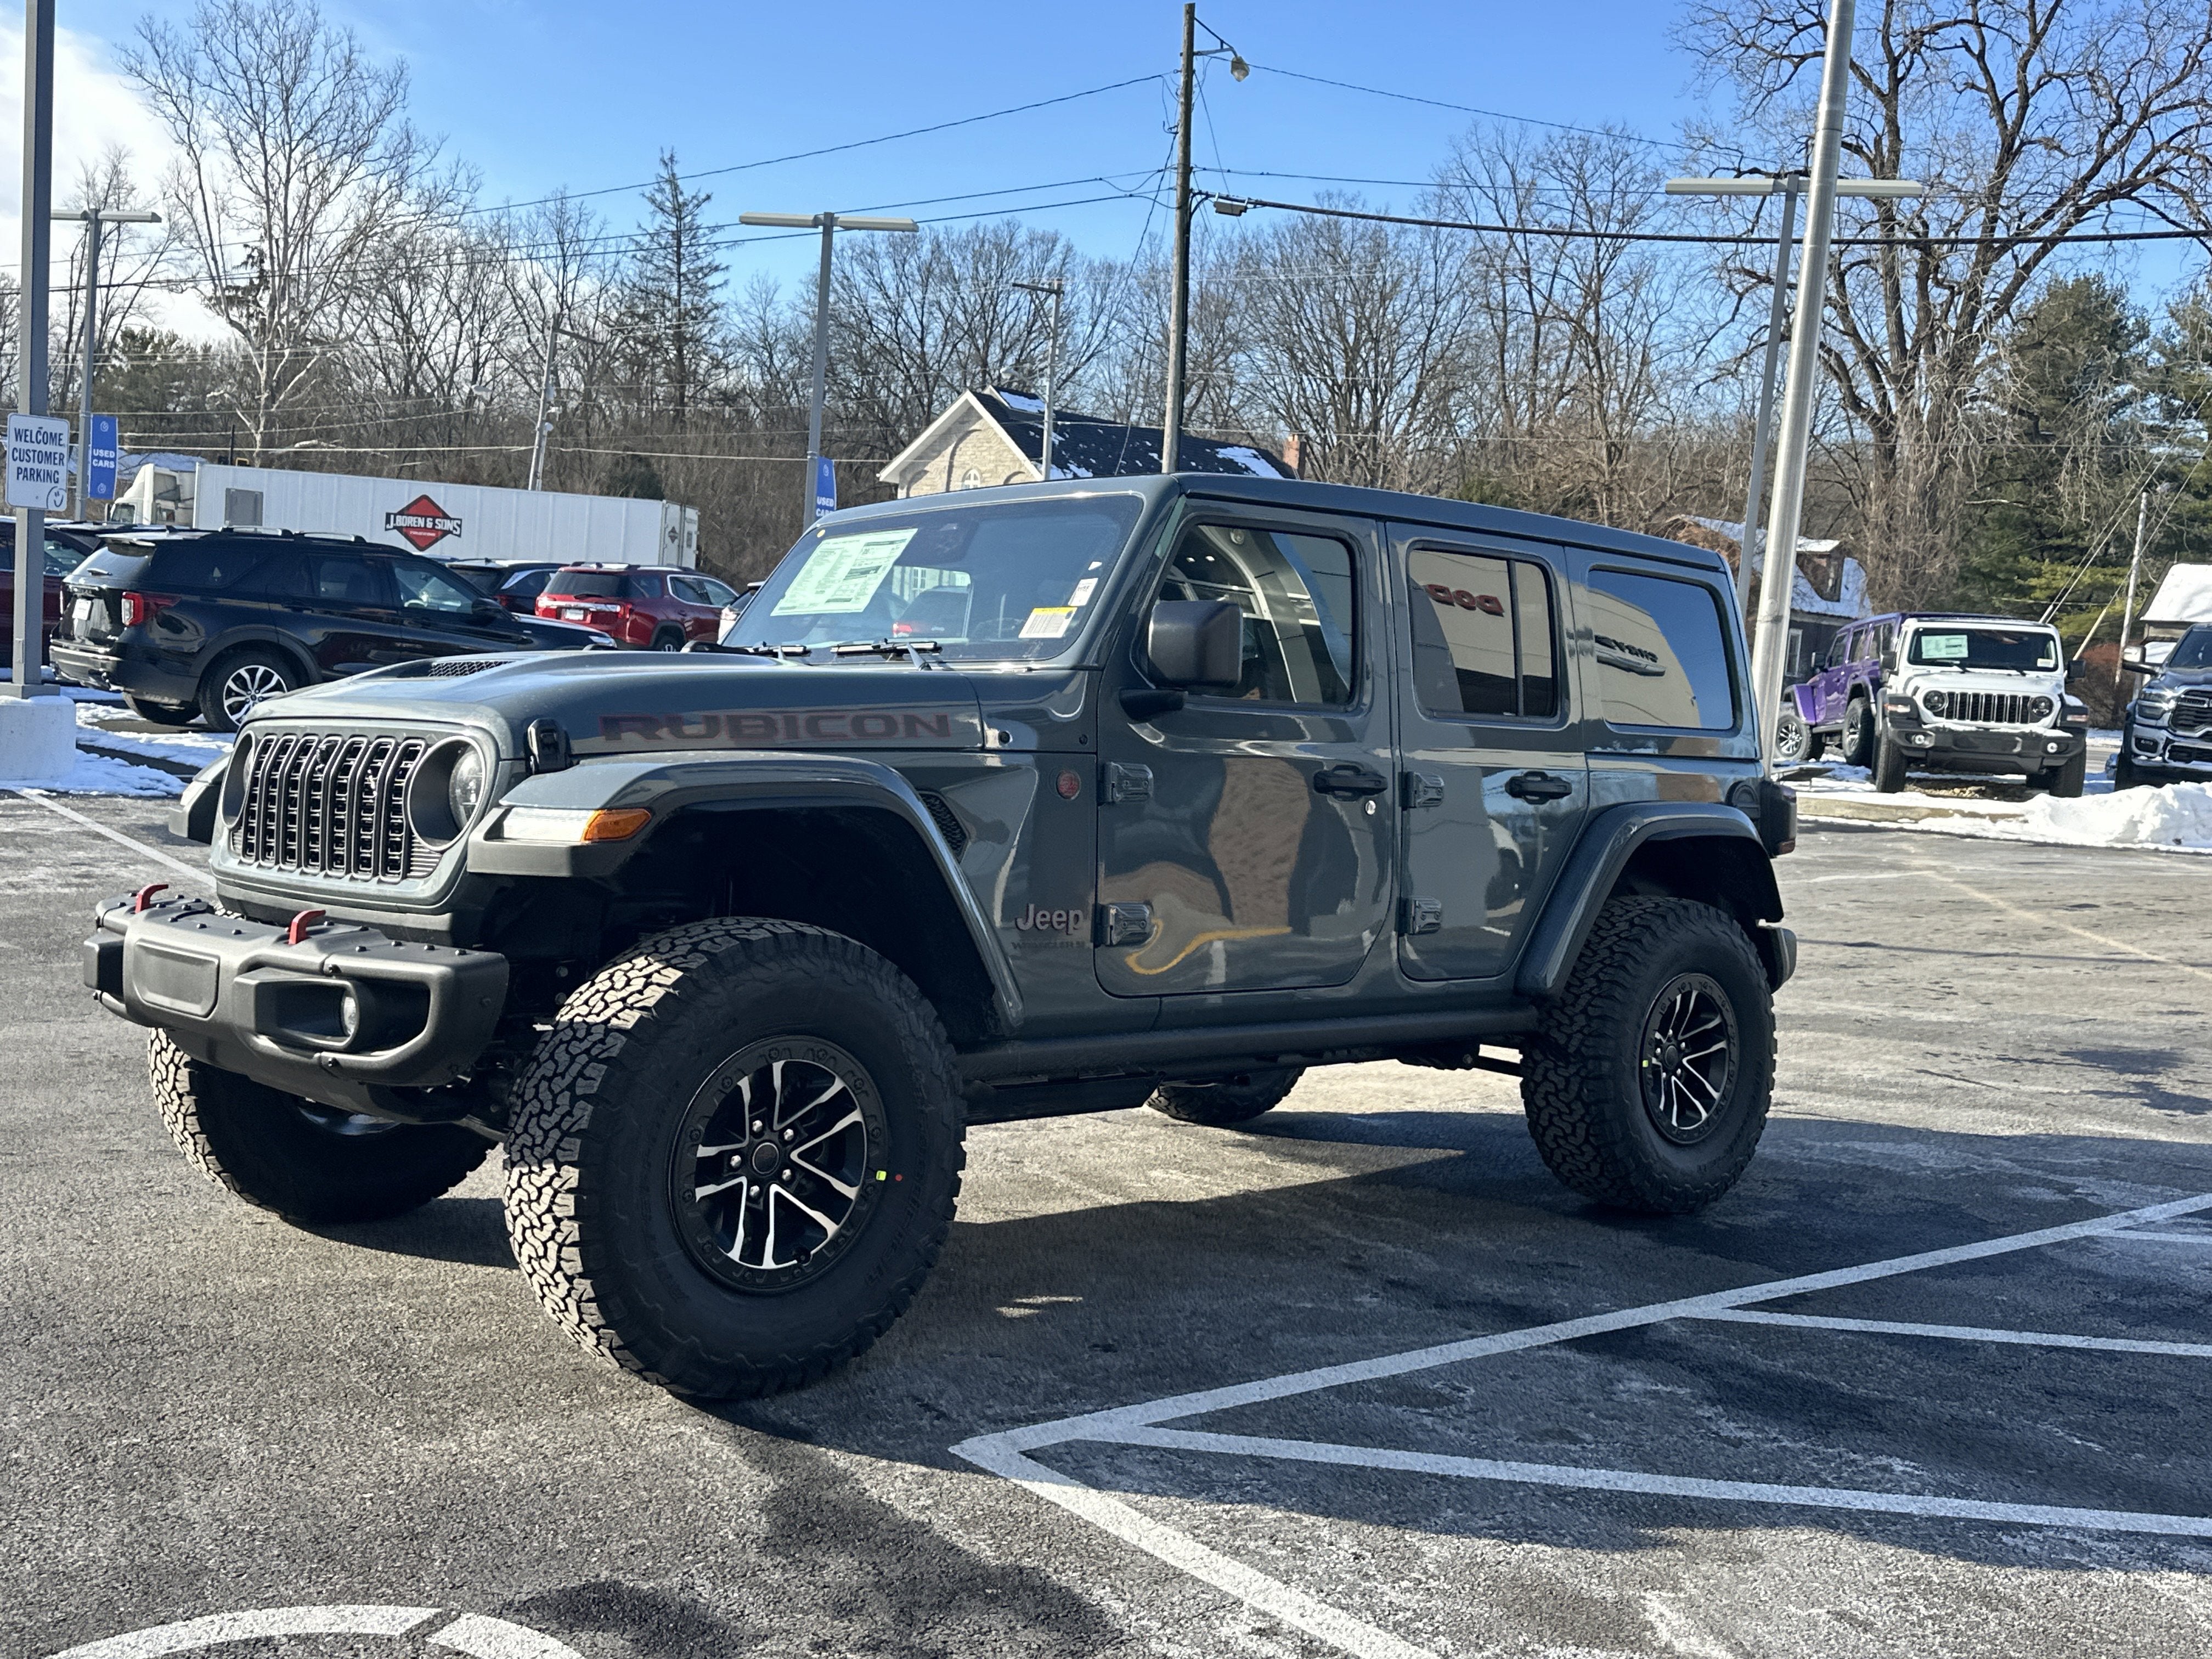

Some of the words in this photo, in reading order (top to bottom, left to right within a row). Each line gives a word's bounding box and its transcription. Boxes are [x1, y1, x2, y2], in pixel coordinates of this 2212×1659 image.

[14, 427, 64, 447] WELCOME
[12, 447, 65, 466] CUSTOMER
[93, 448, 115, 458] USED
[92, 459, 115, 469] CARS
[16, 467, 59, 483] PARKING
[817, 496, 834, 507] USED
[426, 517, 433, 528] &
[435, 518, 461, 534] SONS
[599, 713, 951, 742] RUBICON
[1015, 903, 1084, 935] Jeep
